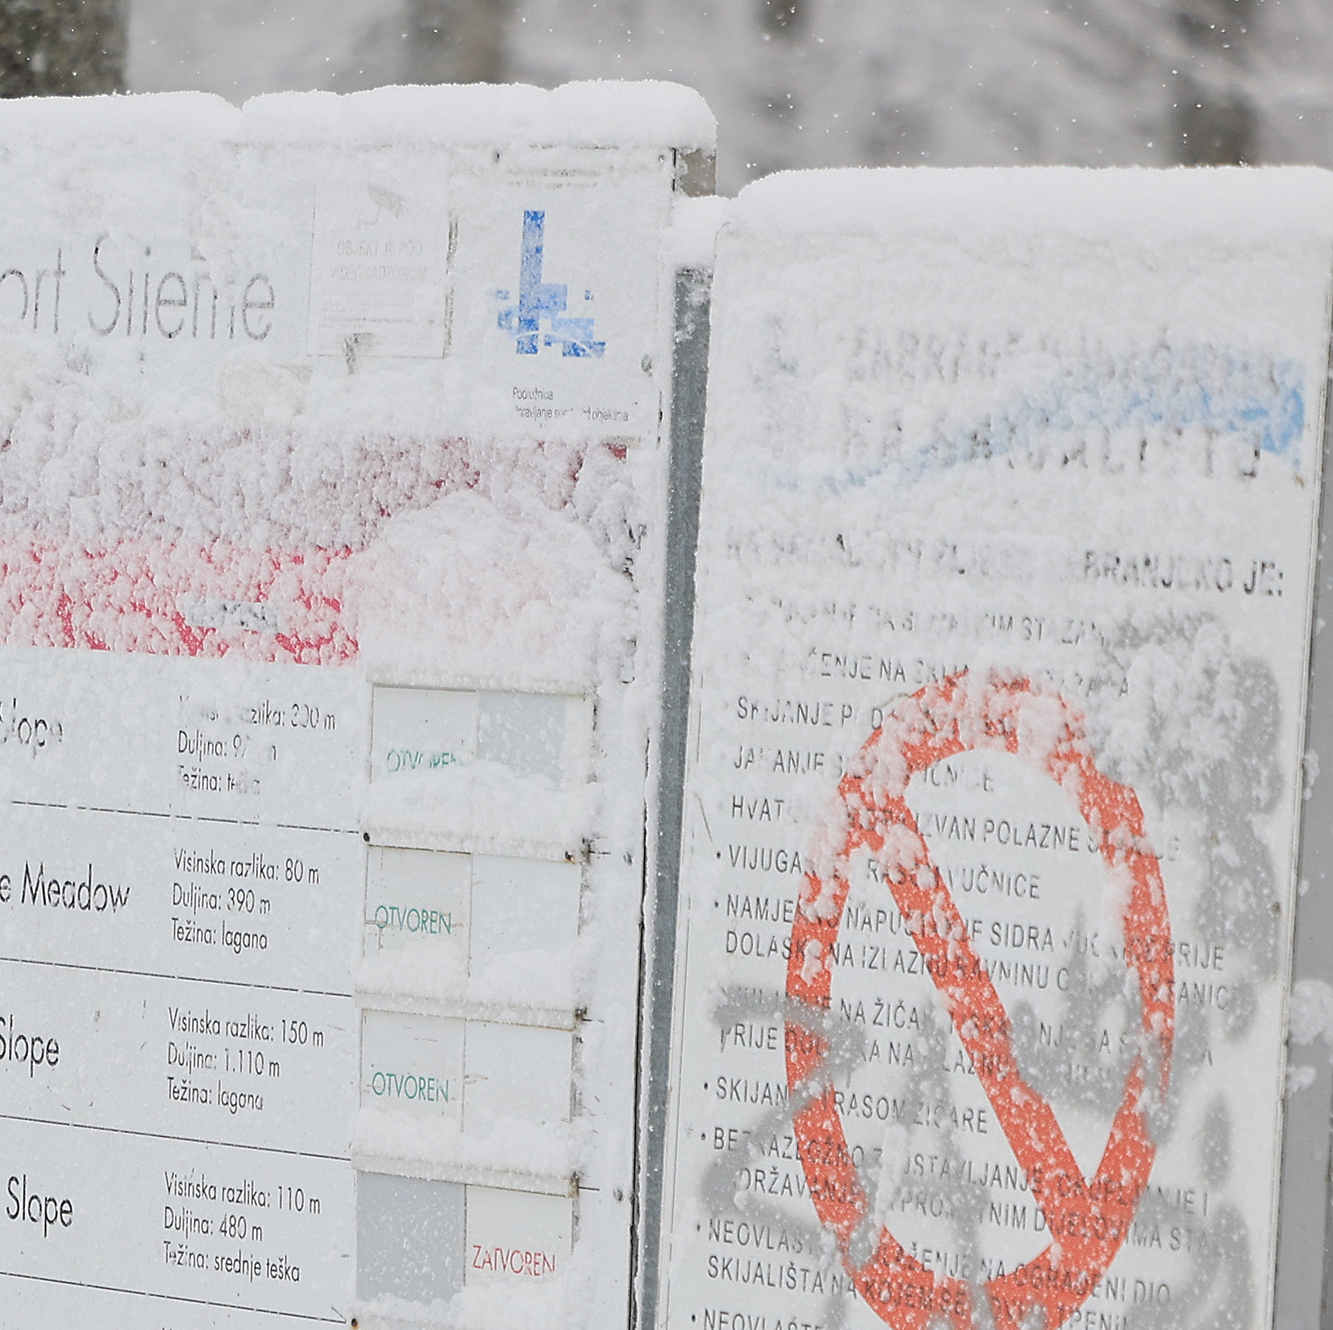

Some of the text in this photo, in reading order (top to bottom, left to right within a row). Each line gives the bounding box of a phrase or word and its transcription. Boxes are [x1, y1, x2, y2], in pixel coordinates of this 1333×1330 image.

[178, 730, 227, 762] Duljina:
[983, 819, 1080, 852] POLAZNE
[174, 848, 304, 883] Visinska razlika: 80
[21, 858, 133, 914] Meadow
[172, 882, 255, 915] Duljina: 390
[171, 917, 268, 955] Težina: lagana
[375, 904, 452, 934] OTVOREN
[989, 921, 1055, 953] SIDRA
[168, 1006, 324, 1048] Visinska razlika: 150 m
[840, 998, 867, 1026] NA
[167, 1041, 280, 1078] Duljina: 1.110 m
[167, 1076, 264, 1115] Težina: lagana
[371, 1071, 449, 1103] OTVOREN
[6, 1174, 74, 1238] Slope
[164, 1171, 321, 1215] Visinska razlika: 110 m
[164, 1206, 263, 1243] Duljina: 480 m
[163, 1240, 301, 1283] Težina: srednje teška
[472, 1244, 556, 1277] ZATVOREN
[707, 1254, 825, 1296] SKIJALIŠTA
[1133, 1279, 1171, 1306] DIO
